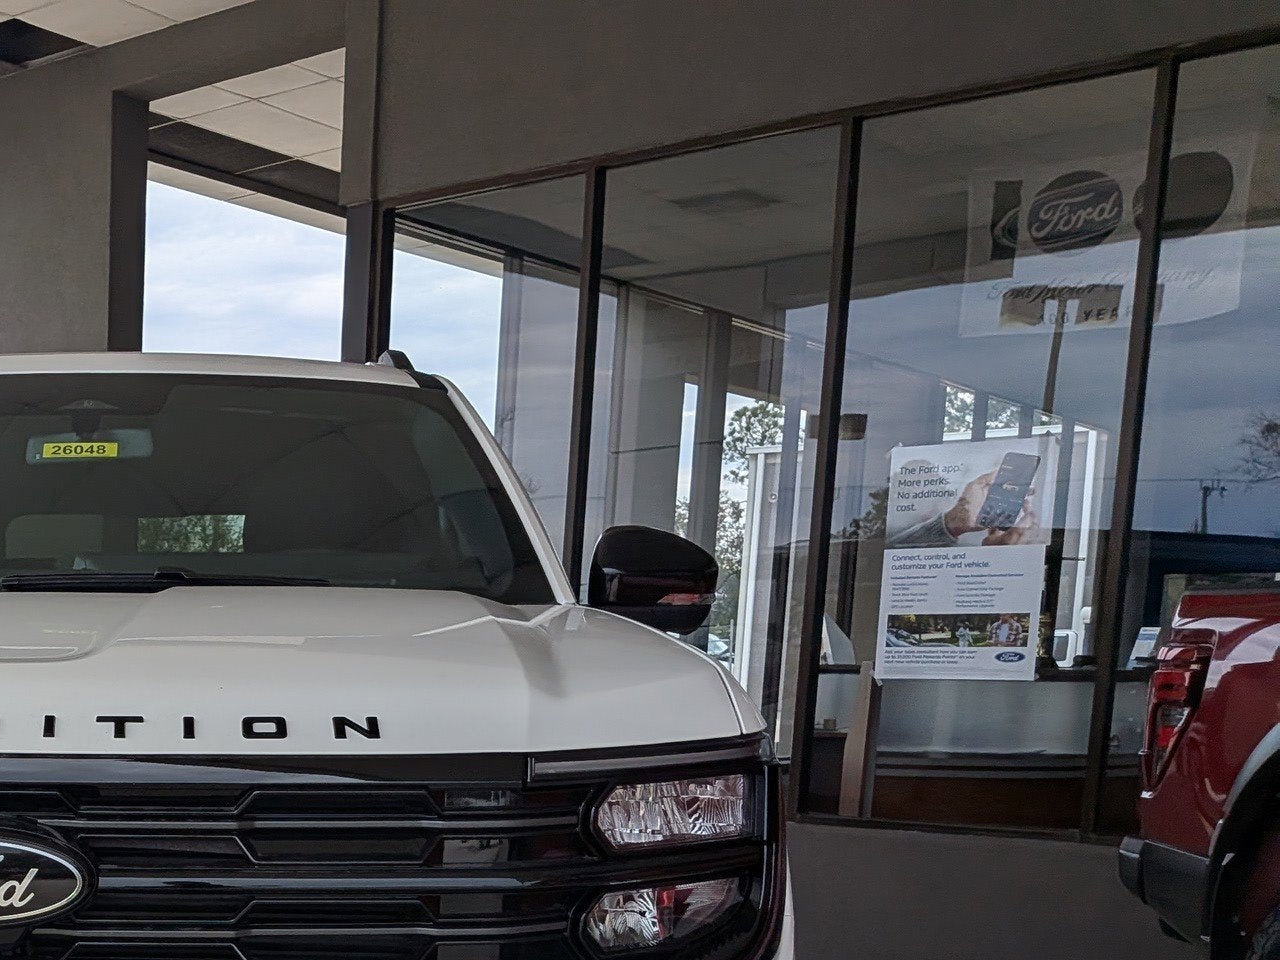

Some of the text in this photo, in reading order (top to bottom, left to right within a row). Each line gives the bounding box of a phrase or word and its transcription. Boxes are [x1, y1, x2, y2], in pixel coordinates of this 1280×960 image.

[1031, 190, 1119, 239] Ford
[51, 444, 107, 455] 26048
[900, 466, 917, 475] The
[918, 464, 940, 474] Ford
[898, 479, 922, 488] More
[897, 488, 959, 500] No additional
[890, 563, 927, 571] customize
[928, 562, 945, 571] your
[945, 561, 963, 570] Ford
